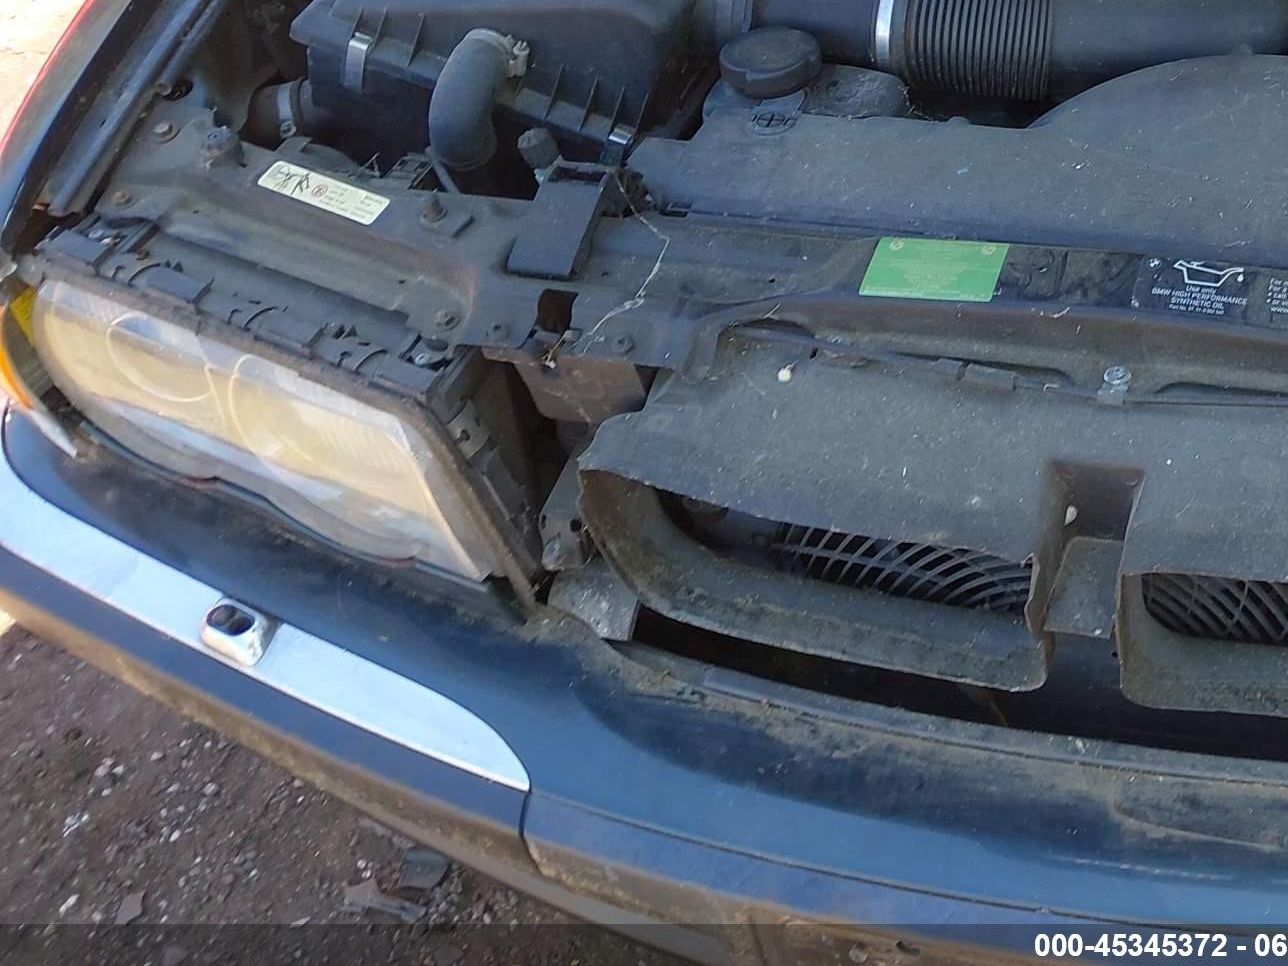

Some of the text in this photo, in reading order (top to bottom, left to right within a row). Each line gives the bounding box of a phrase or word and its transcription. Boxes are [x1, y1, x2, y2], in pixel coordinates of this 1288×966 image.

[1152, 287, 1171, 296] BMW
[1191, 293, 1248, 305] PERFORMANCE
[1171, 297, 1211, 307] SYNTHETIC
